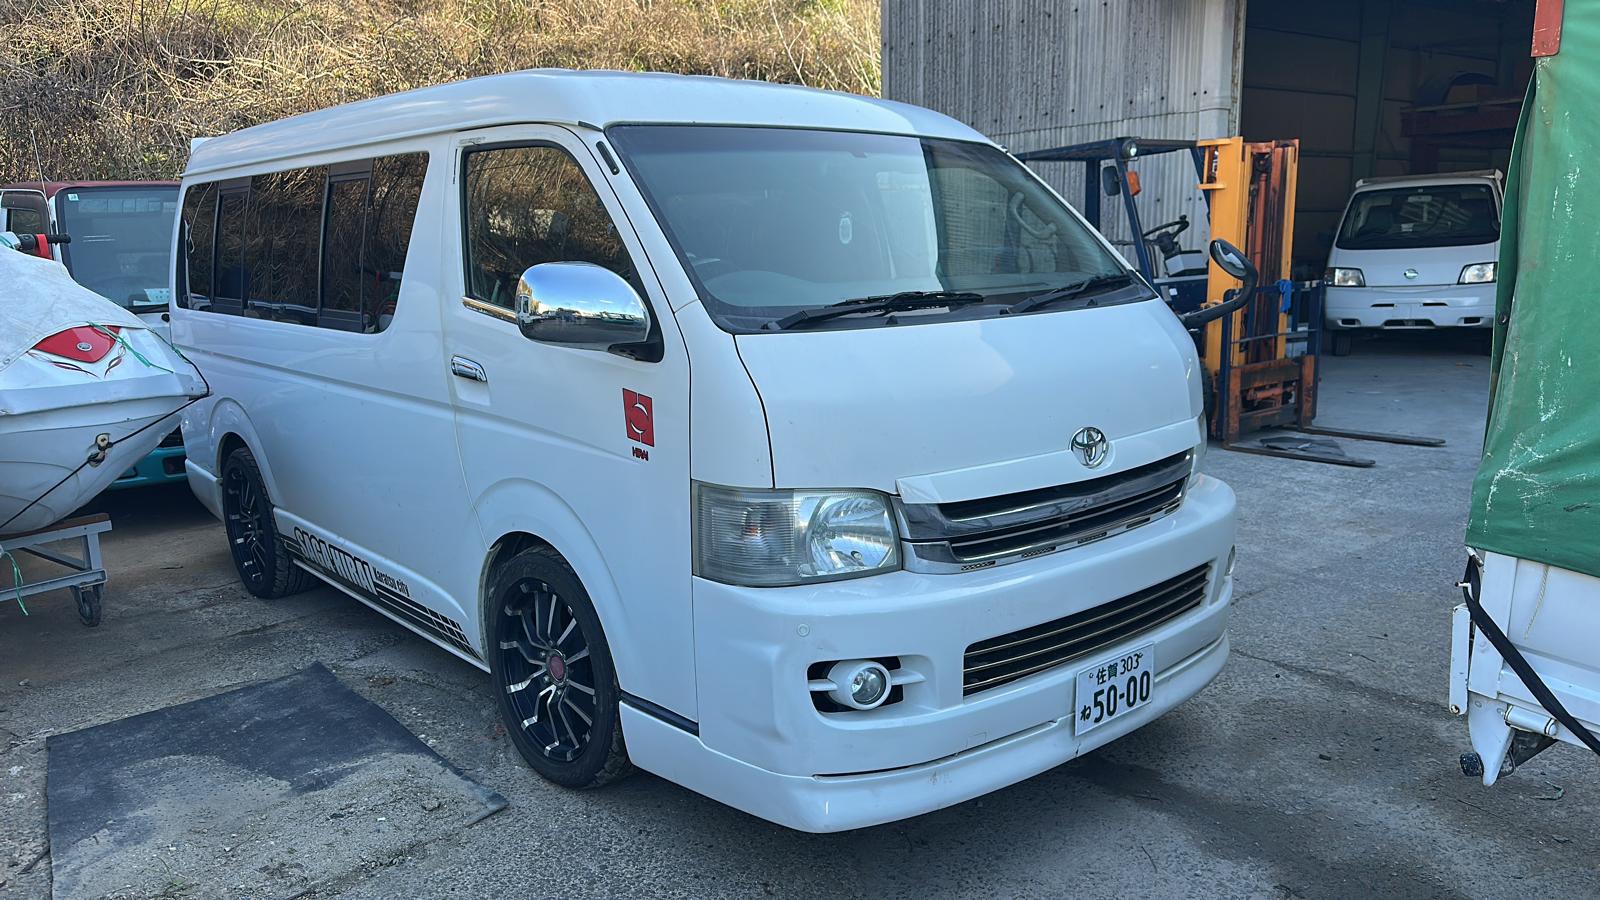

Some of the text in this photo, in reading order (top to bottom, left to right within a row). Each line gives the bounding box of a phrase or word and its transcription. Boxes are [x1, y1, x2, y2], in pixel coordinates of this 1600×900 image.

[294, 526, 379, 595] SAGA HIRAI
[396, 579, 410, 597] city
[1096, 653, 1140, 685] 佐賀 303
[1080, 670, 1150, 723] ね 50-00
